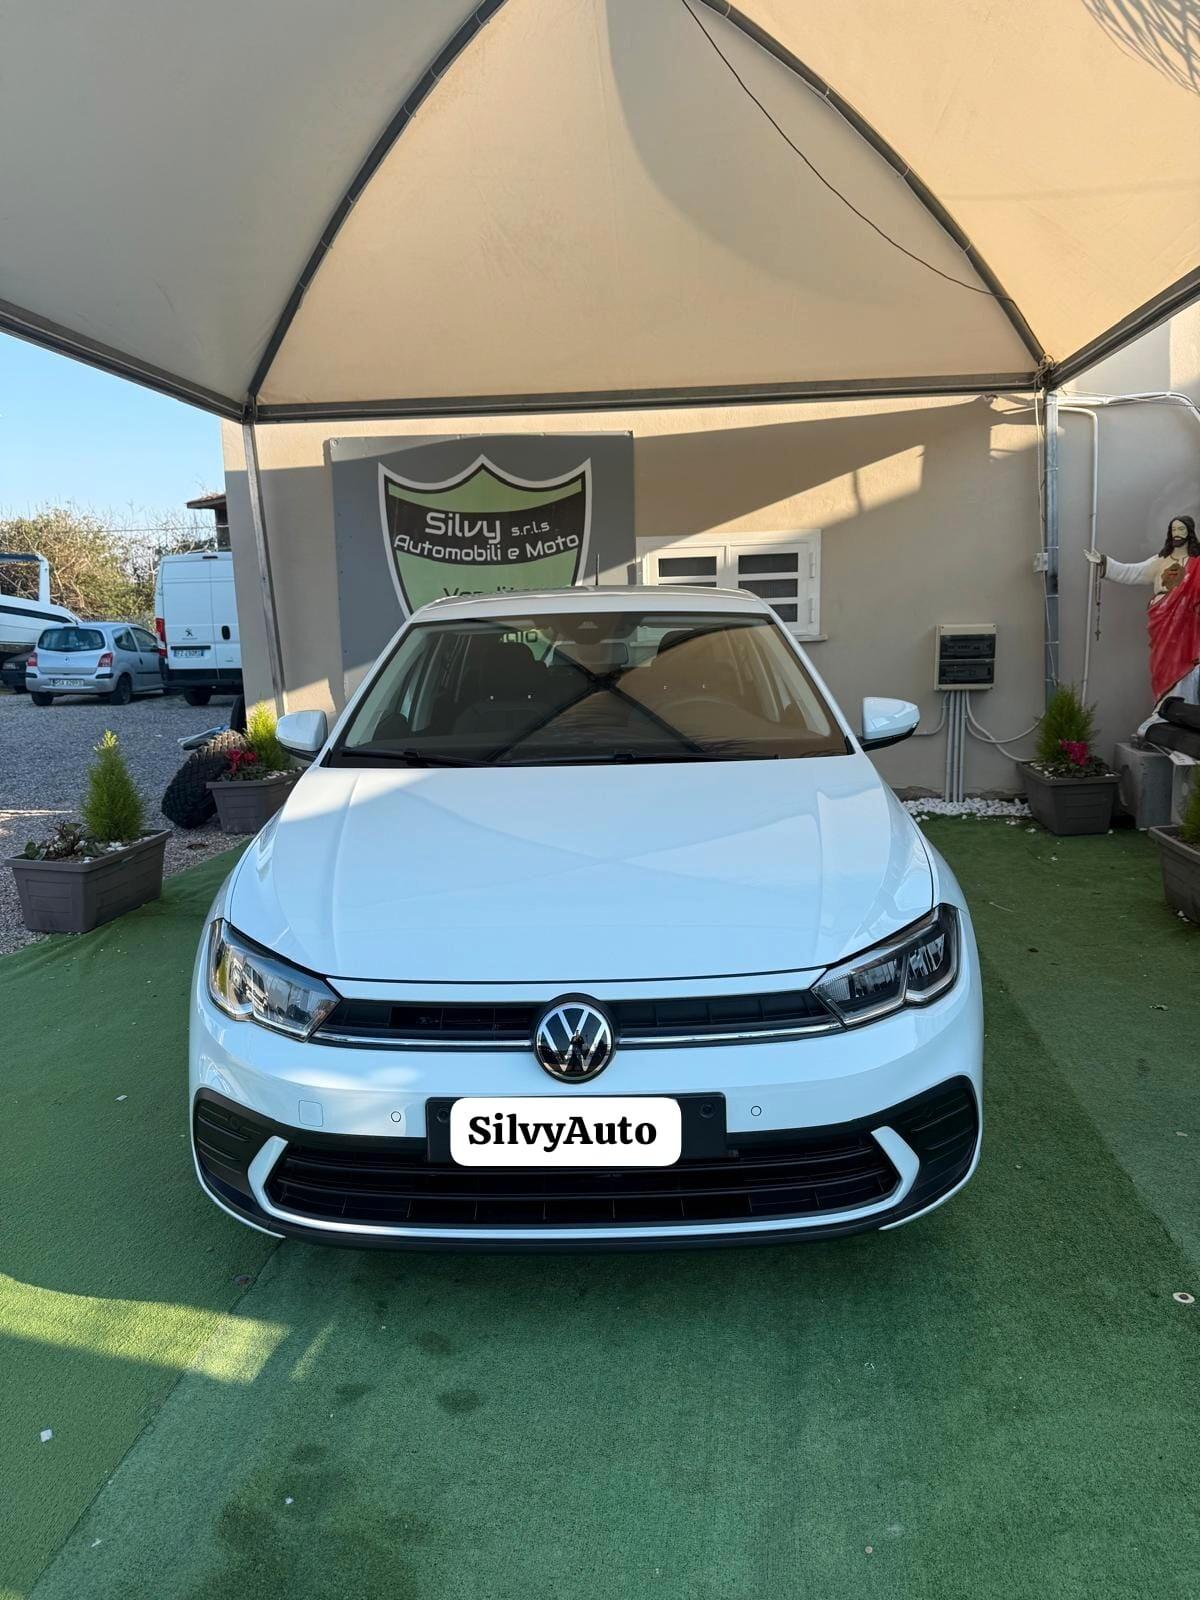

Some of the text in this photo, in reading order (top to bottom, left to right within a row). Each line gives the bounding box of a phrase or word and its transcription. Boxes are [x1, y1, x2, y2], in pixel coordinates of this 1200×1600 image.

[425, 511, 550, 544] Silvy s.r.l.s
[393, 534, 579, 561] Automobili e Moto
